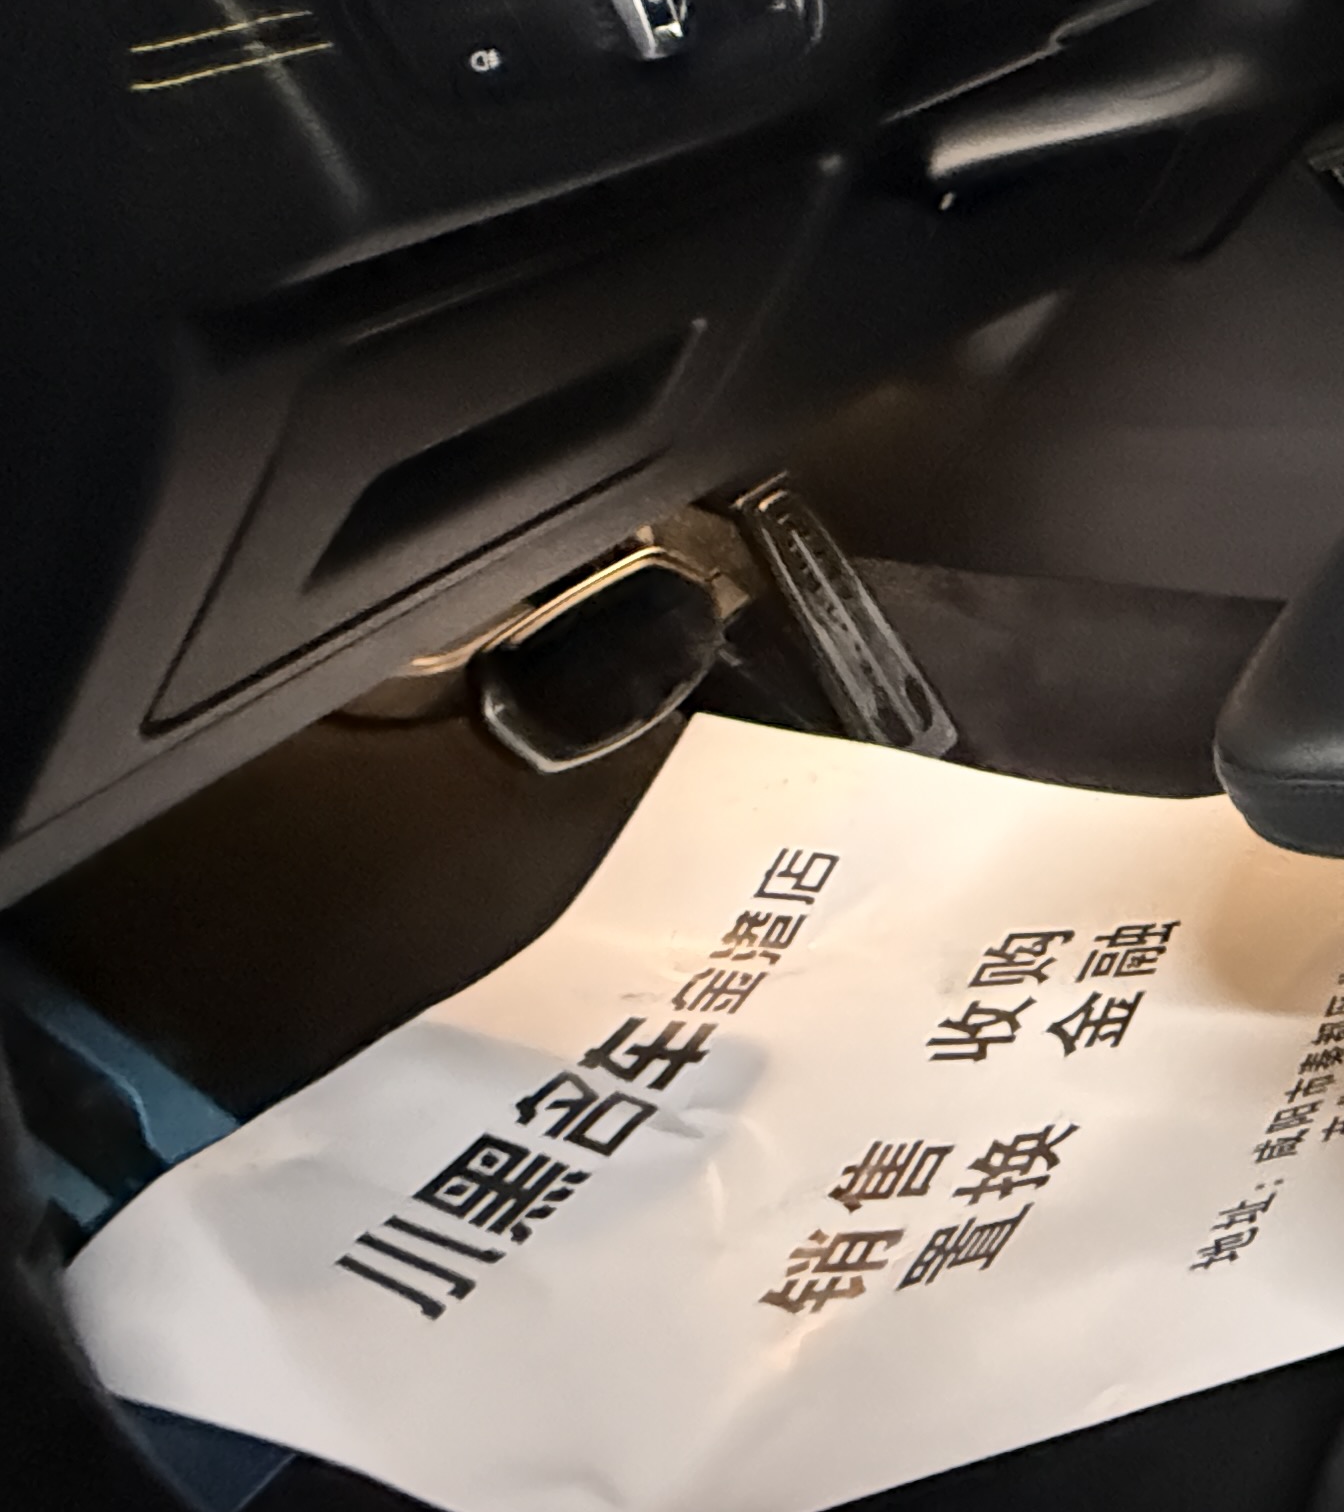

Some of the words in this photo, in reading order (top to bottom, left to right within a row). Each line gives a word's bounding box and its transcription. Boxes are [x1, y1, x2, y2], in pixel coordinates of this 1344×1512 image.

[926, 929, 1075, 1062] 收购
[1046, 919, 1182, 1057] 金融
[758, 1140, 956, 1314] 销售
[895, 1122, 1080, 1292] 置换
